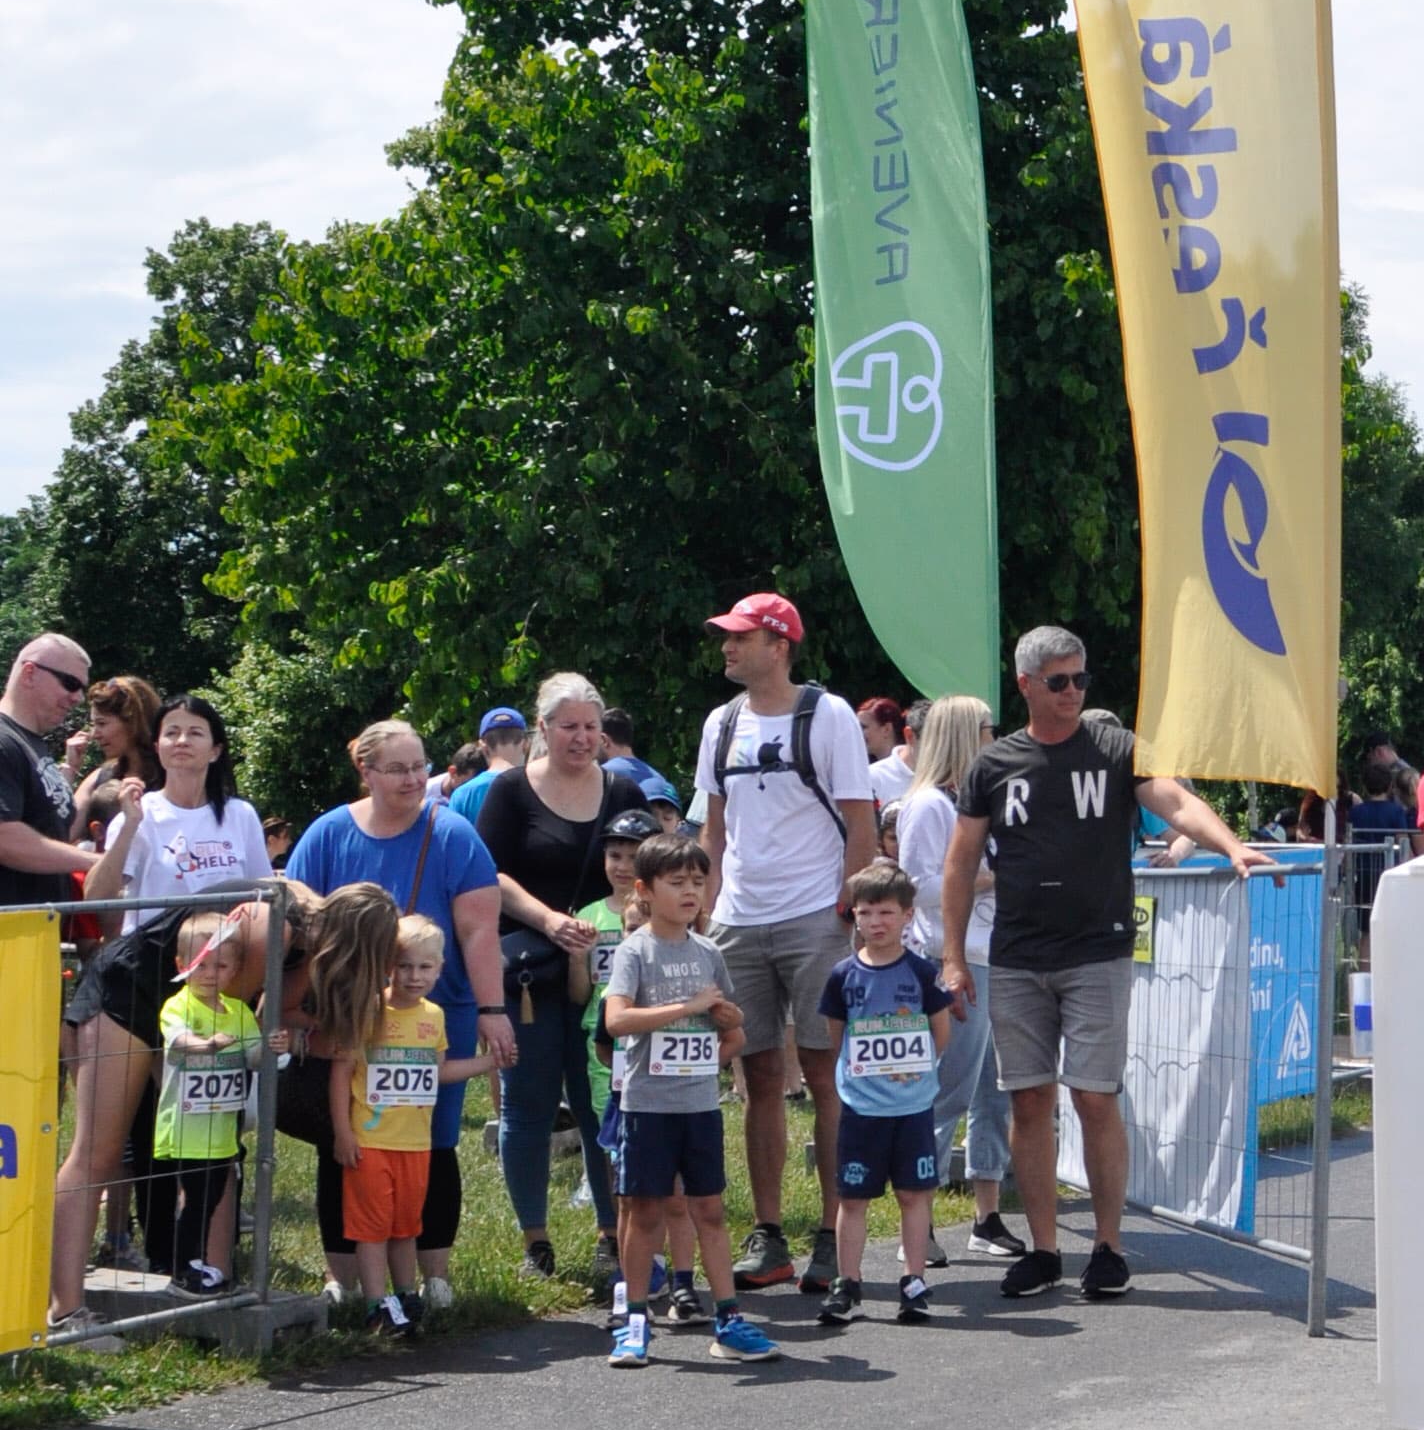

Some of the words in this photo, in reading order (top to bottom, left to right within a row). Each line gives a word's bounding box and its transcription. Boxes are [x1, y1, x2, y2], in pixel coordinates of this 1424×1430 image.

[196, 855, 238, 870] HELP
[1249, 936, 1284, 971] dinu,
[661, 962, 689, 979] WHO
[661, 1035, 714, 1061] 2136
[856, 1035, 925, 1063] 2004
[187, 1073, 244, 1100] 2079
[375, 1067, 434, 1092] 2076
